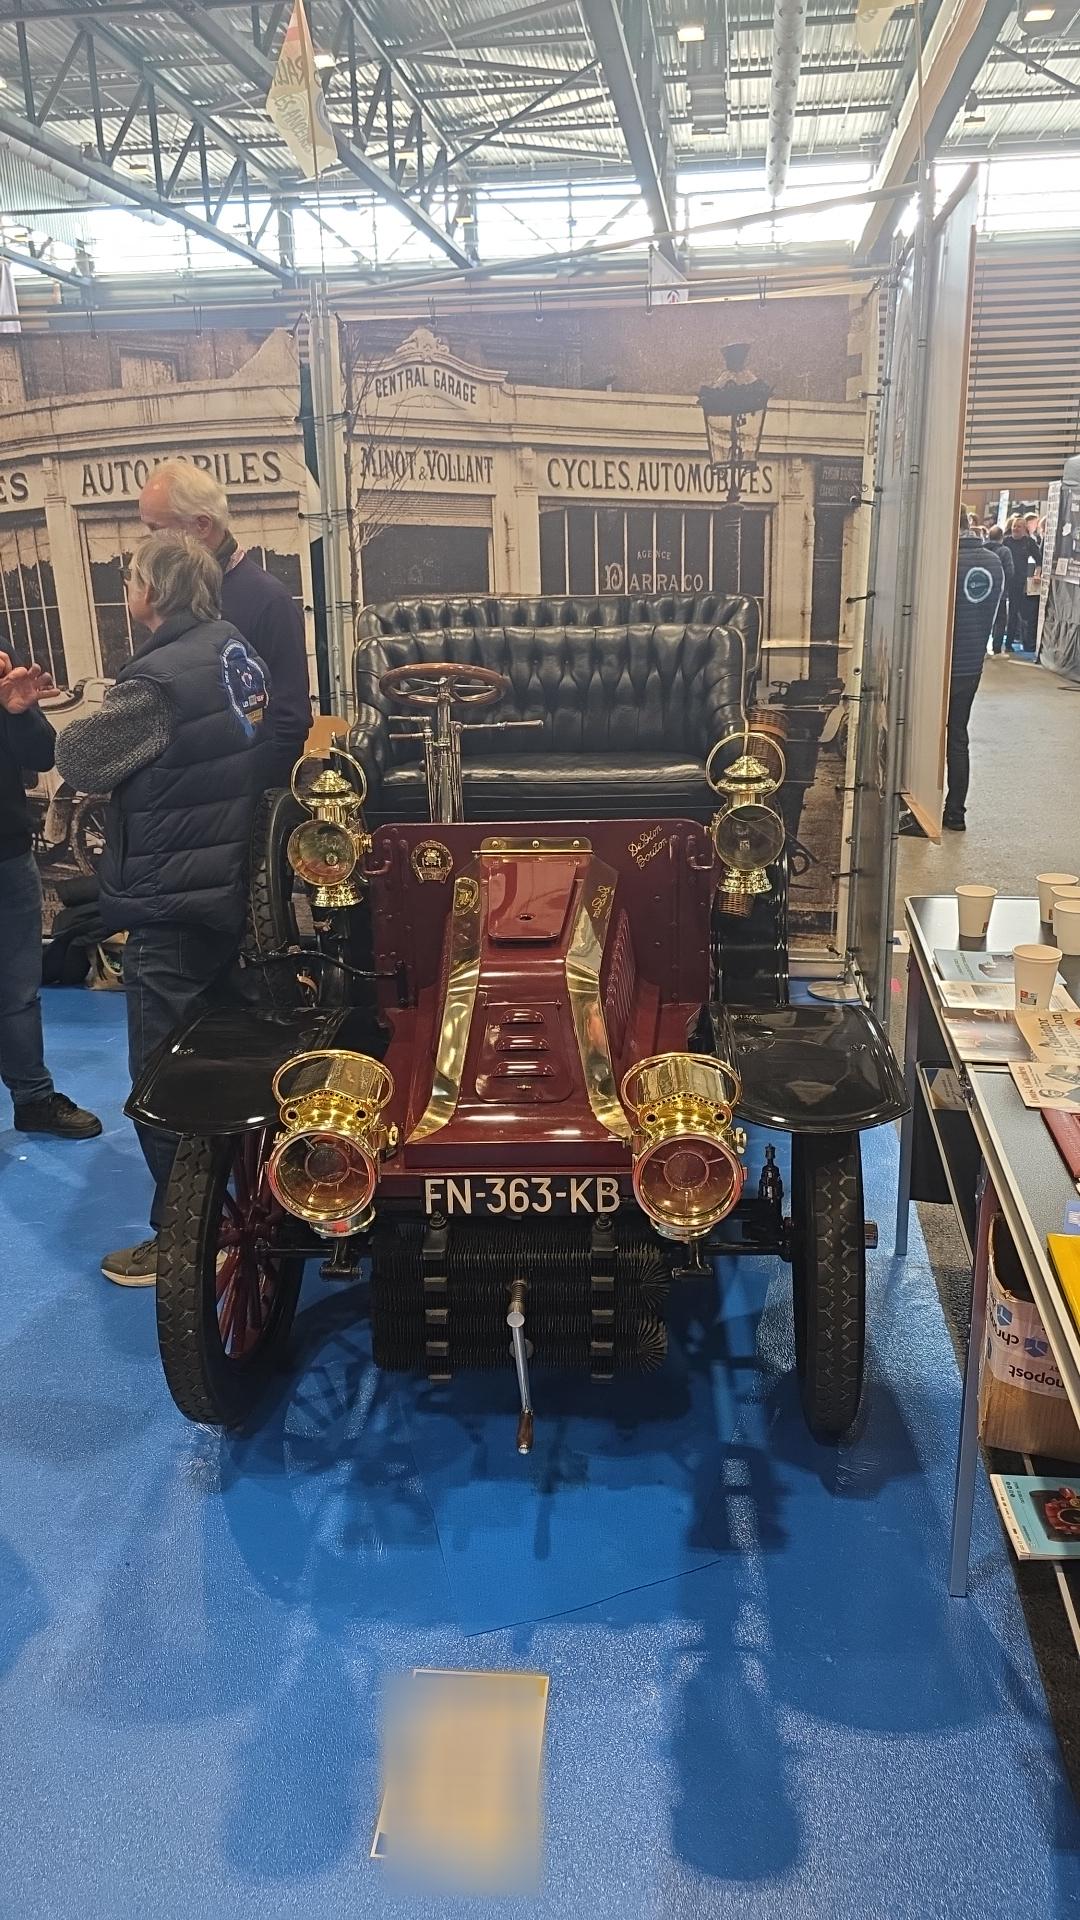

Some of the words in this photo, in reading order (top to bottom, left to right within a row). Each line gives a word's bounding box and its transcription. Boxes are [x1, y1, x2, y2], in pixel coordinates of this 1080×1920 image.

[375, 367, 429, 398] CENTRAL
[433, 369, 477, 404] GARAGE
[82, 451, 281, 497] AUTOBILES
[360, 446, 417, 480] MINOT
[418, 466, 428, 481] &
[423, 449, 493, 483] VOLLANT
[637, 550, 671, 560] AGENCE
[636, 838, 668, 870] Bouton
[425, 1177, 620, 1215] FN-363-KB
